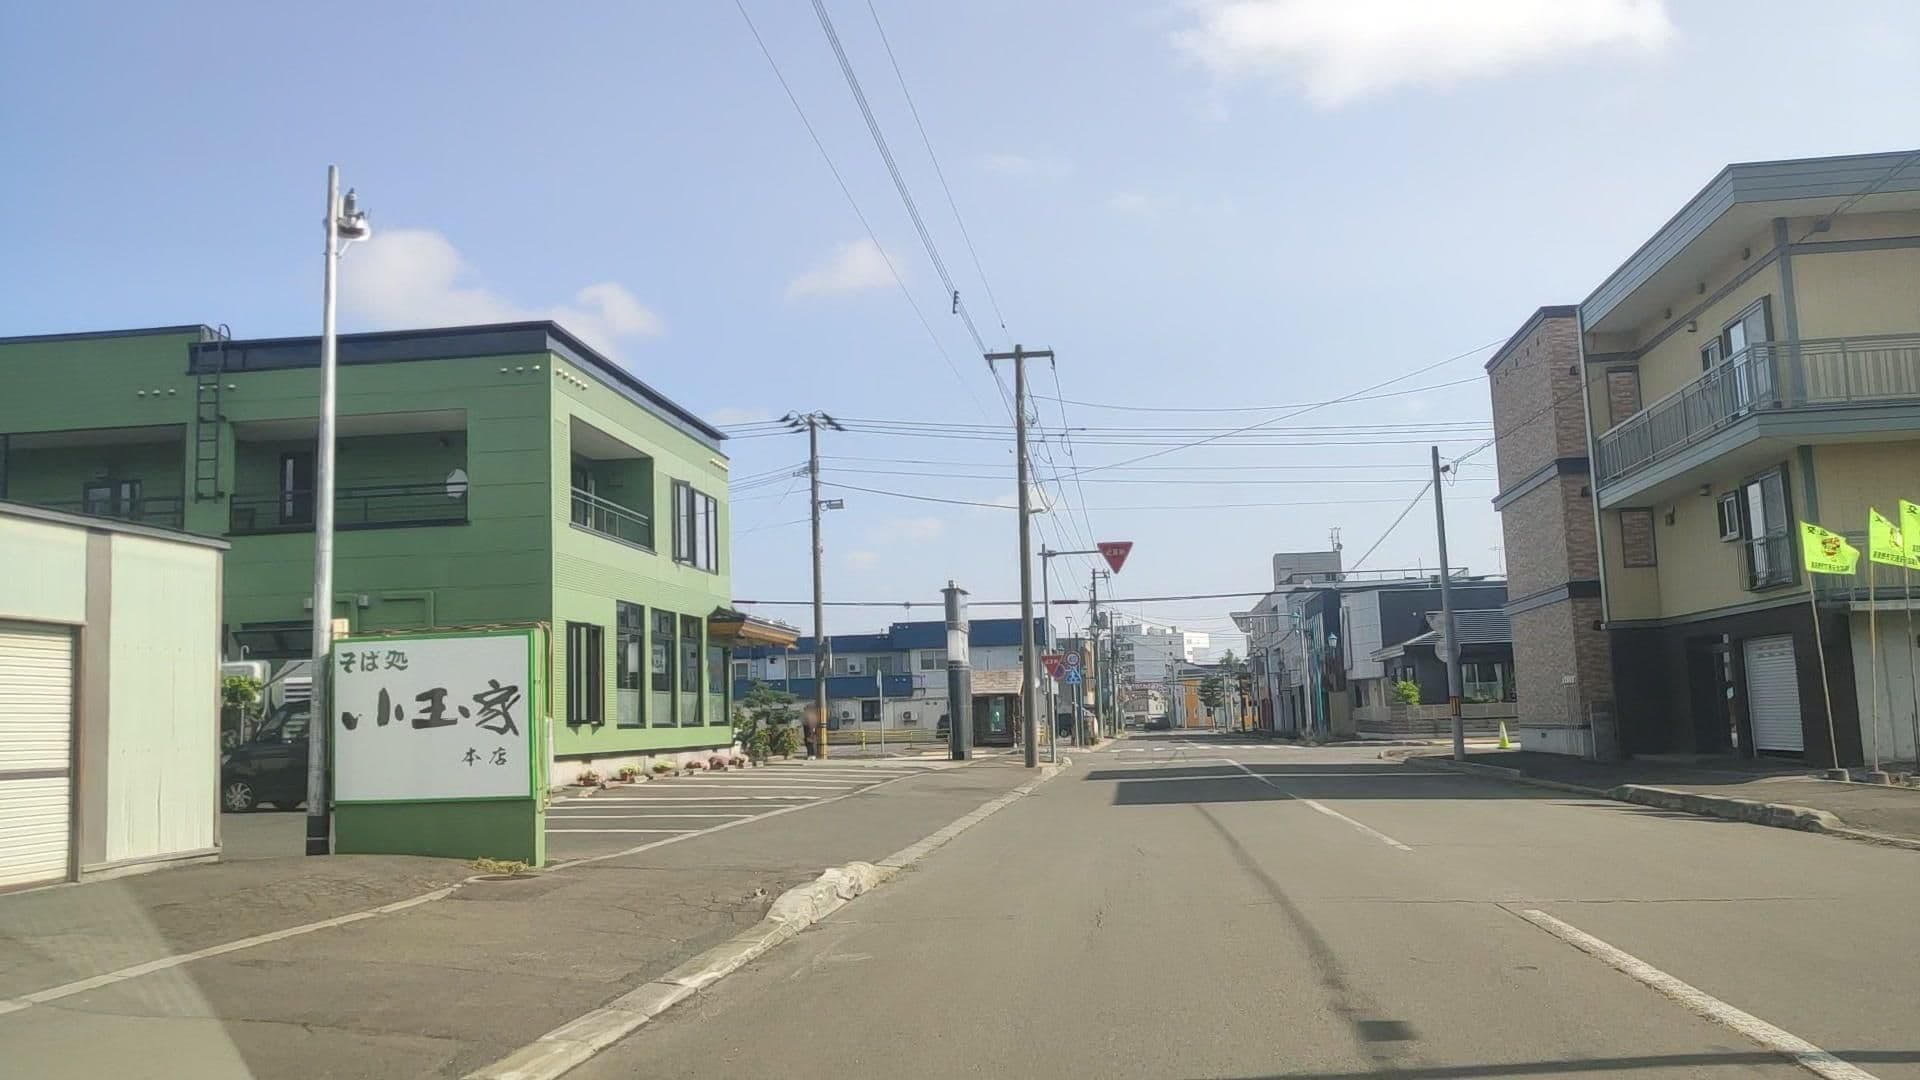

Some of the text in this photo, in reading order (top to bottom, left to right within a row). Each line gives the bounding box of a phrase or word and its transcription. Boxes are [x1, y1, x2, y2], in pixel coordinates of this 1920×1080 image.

[339, 650, 408, 673] そば処
[341, 679, 521, 736] 小玉家
[462, 747, 508, 766] 本店
